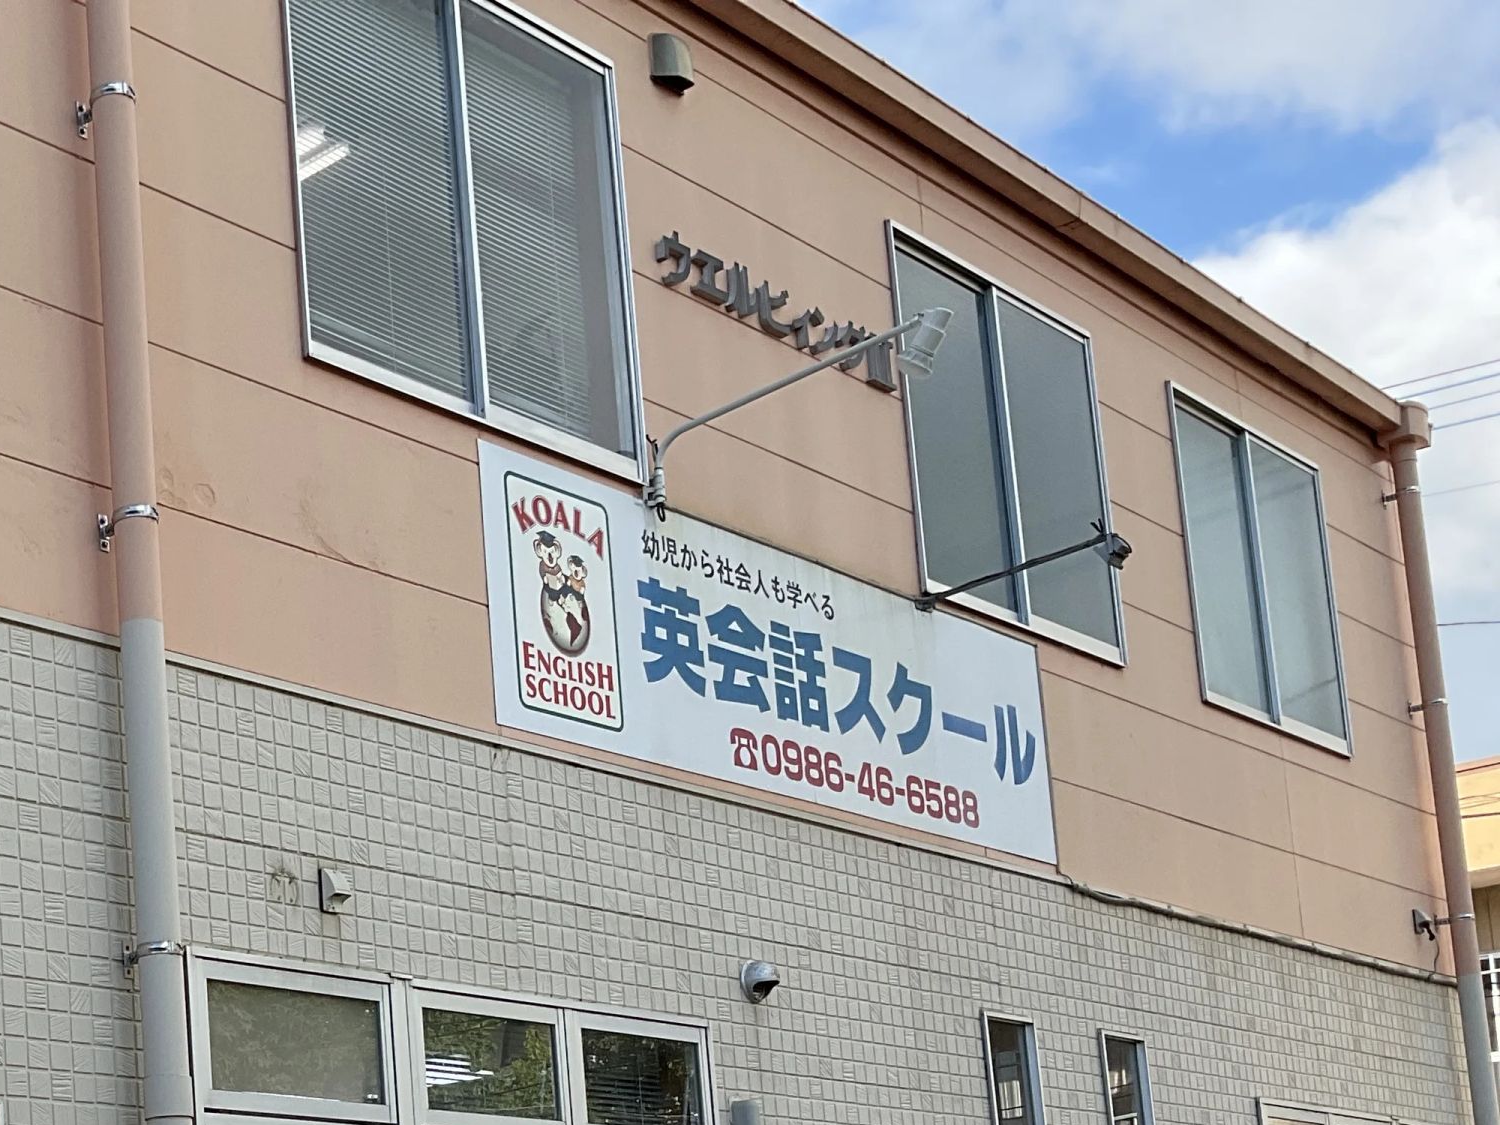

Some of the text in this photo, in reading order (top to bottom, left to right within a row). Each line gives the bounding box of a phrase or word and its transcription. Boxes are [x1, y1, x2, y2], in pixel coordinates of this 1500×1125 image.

[511, 495, 605, 560] KOALA
[641, 529, 835, 621] 幼児から社会人も学べる
[522, 641, 615, 692] ENGLISH
[525, 674, 617, 719] SCHOOL
[637, 576, 1036, 786] 英会話スクール
